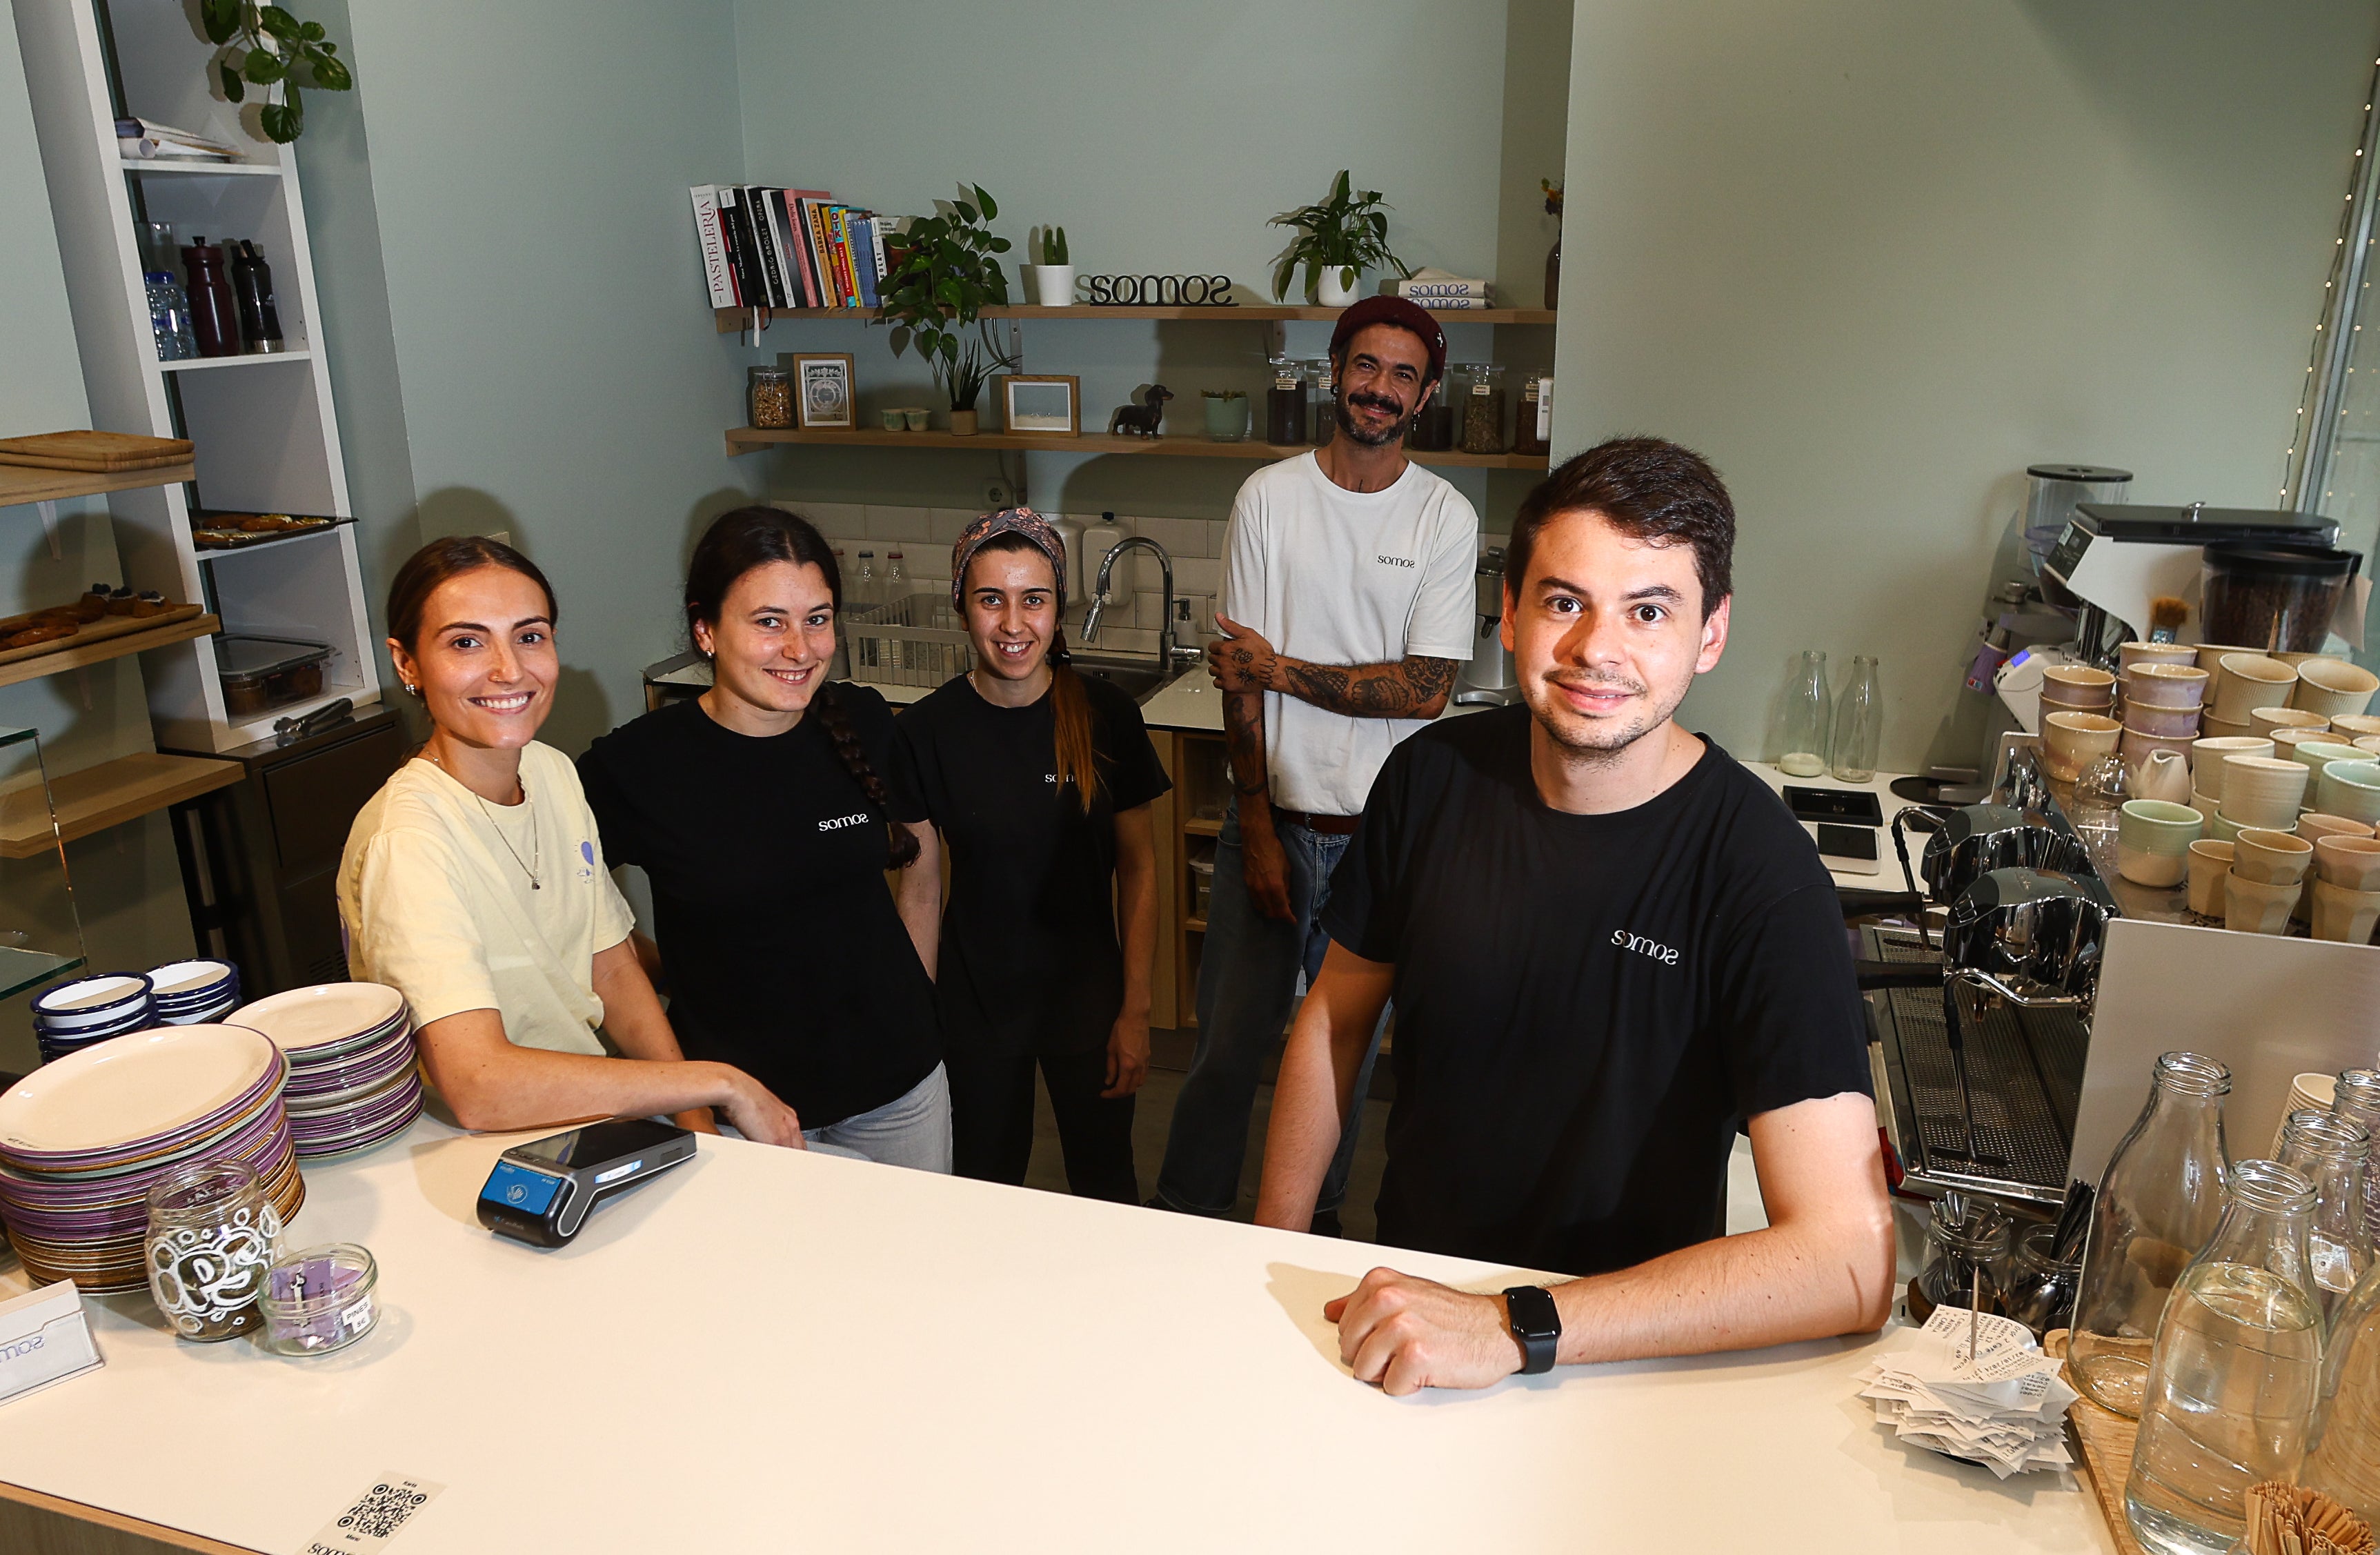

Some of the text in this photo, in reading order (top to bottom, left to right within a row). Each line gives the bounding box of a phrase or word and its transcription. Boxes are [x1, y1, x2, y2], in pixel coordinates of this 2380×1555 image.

[816, 230, 824, 254] BABKA
[1090, 275, 1232, 304] somos
[1409, 284, 1469, 296] somos
[1377, 555, 1415, 568] somos
[818, 813, 869, 831] somos
[1611, 929, 1679, 965] somos
[346, 1302, 368, 1320] PINES
[0, 1335, 45, 1363] mos
